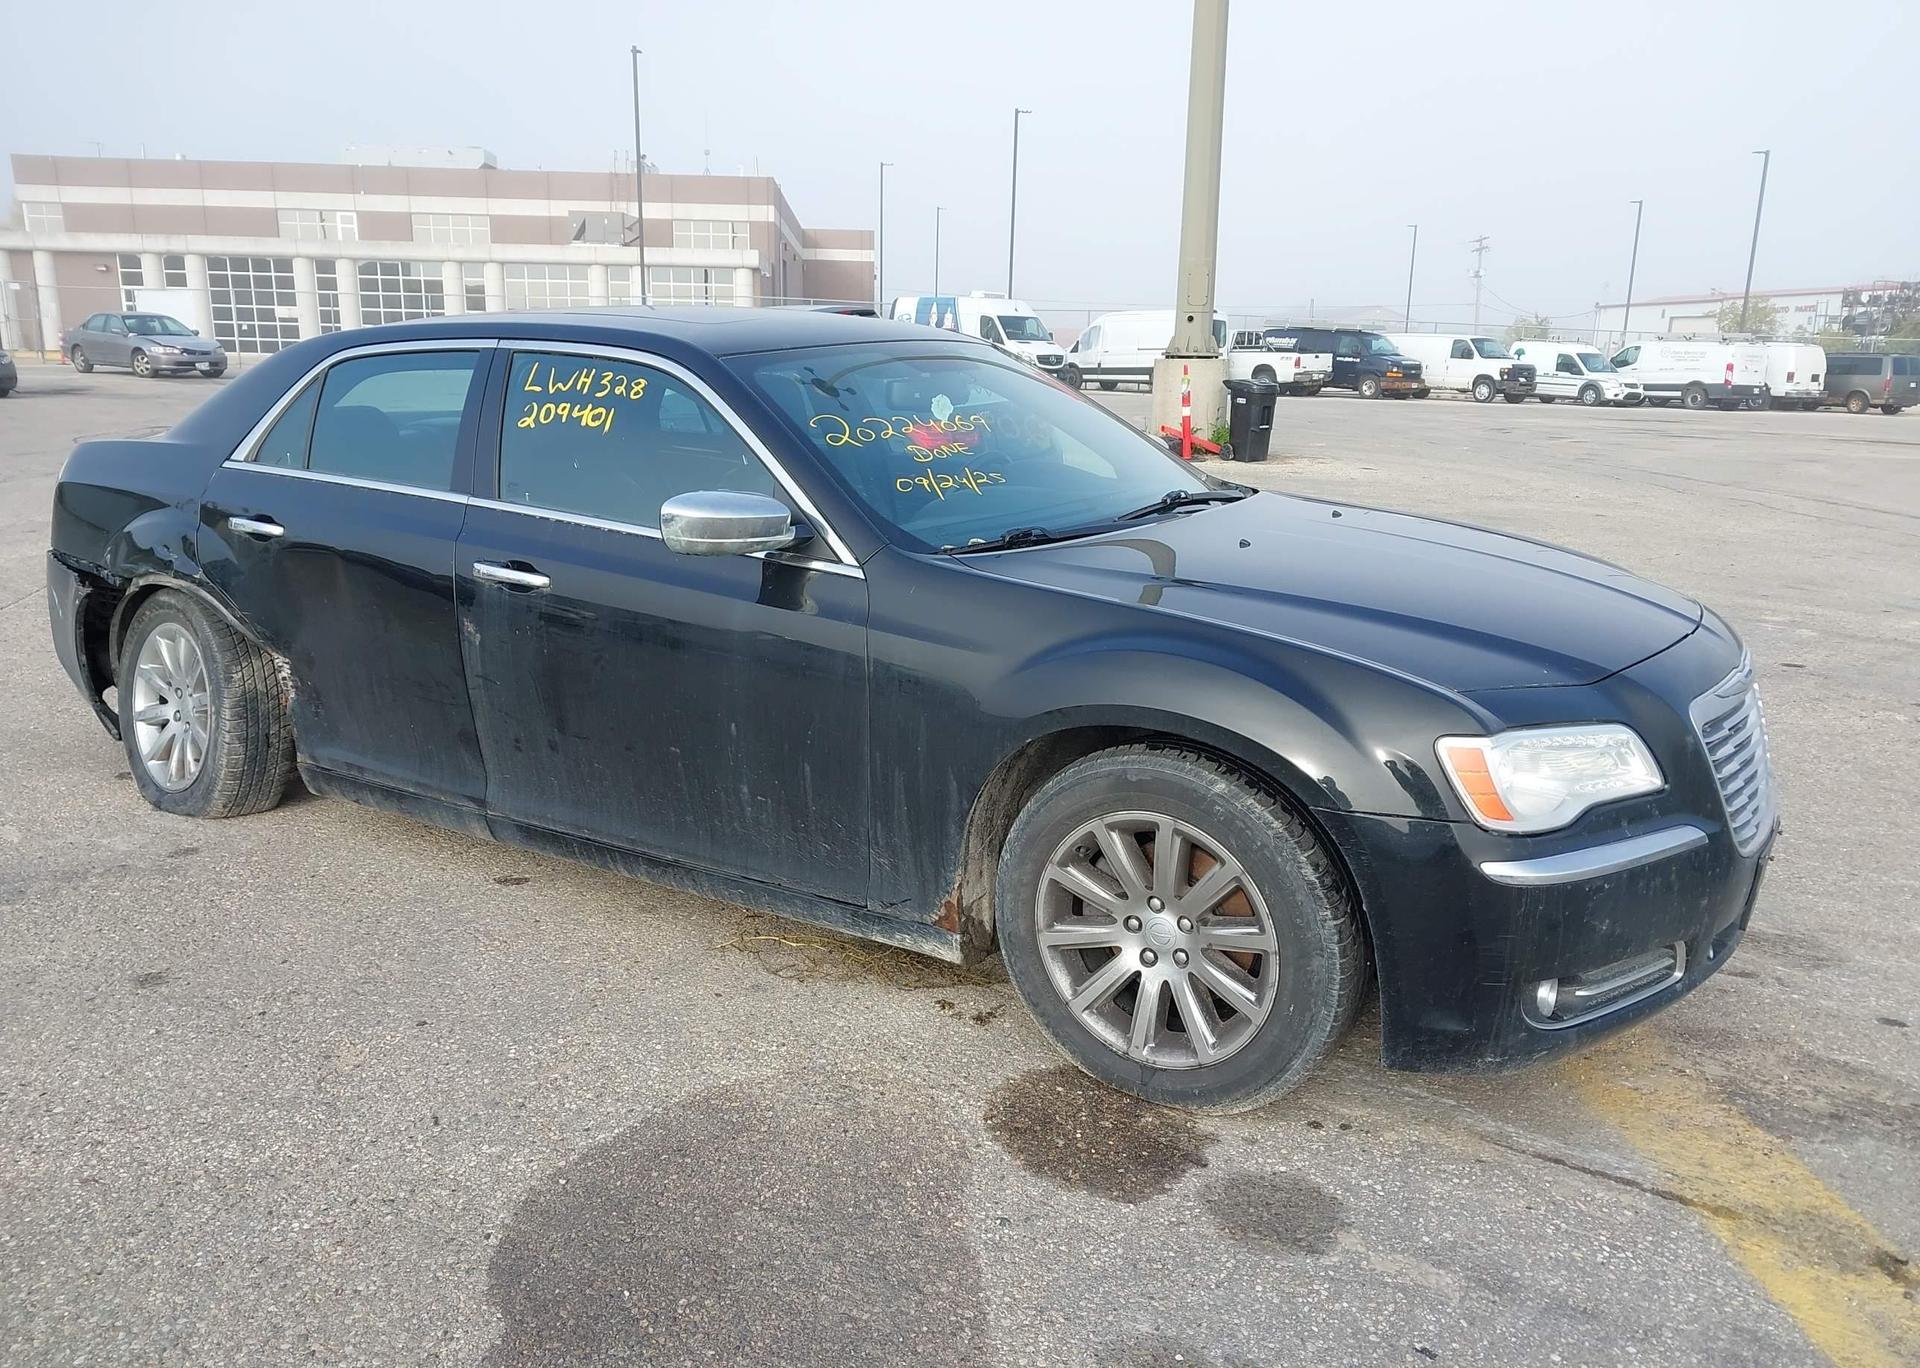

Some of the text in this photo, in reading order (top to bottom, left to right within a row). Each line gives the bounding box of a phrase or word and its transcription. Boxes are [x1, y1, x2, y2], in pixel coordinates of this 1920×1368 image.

[516, 402, 615, 435] 209401
[809, 414, 992, 447] 20224069
[904, 442, 974, 462] DONE
[896, 468, 1006, 500] 09/24/25
